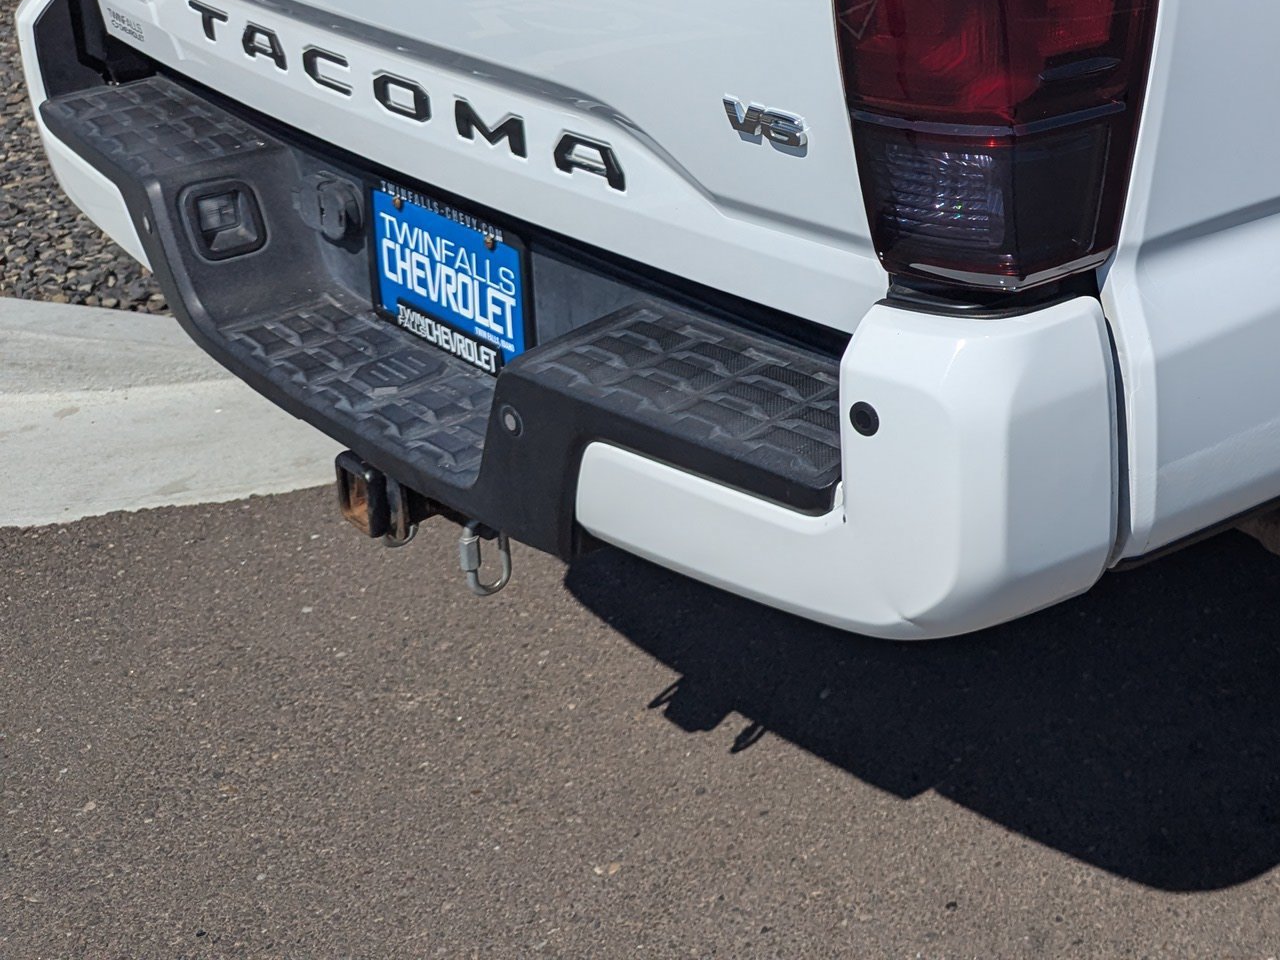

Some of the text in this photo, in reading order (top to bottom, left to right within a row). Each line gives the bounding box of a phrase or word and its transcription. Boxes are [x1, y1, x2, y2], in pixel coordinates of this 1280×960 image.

[722, 94, 808, 147] V6
[380, 211, 515, 296] TWINFALLS
[381, 237, 516, 339] CHEVROLET
[397, 303, 426, 328] TWIN
[398, 315, 427, 338] FALLS
[424, 318, 497, 373] CHEVROLET
